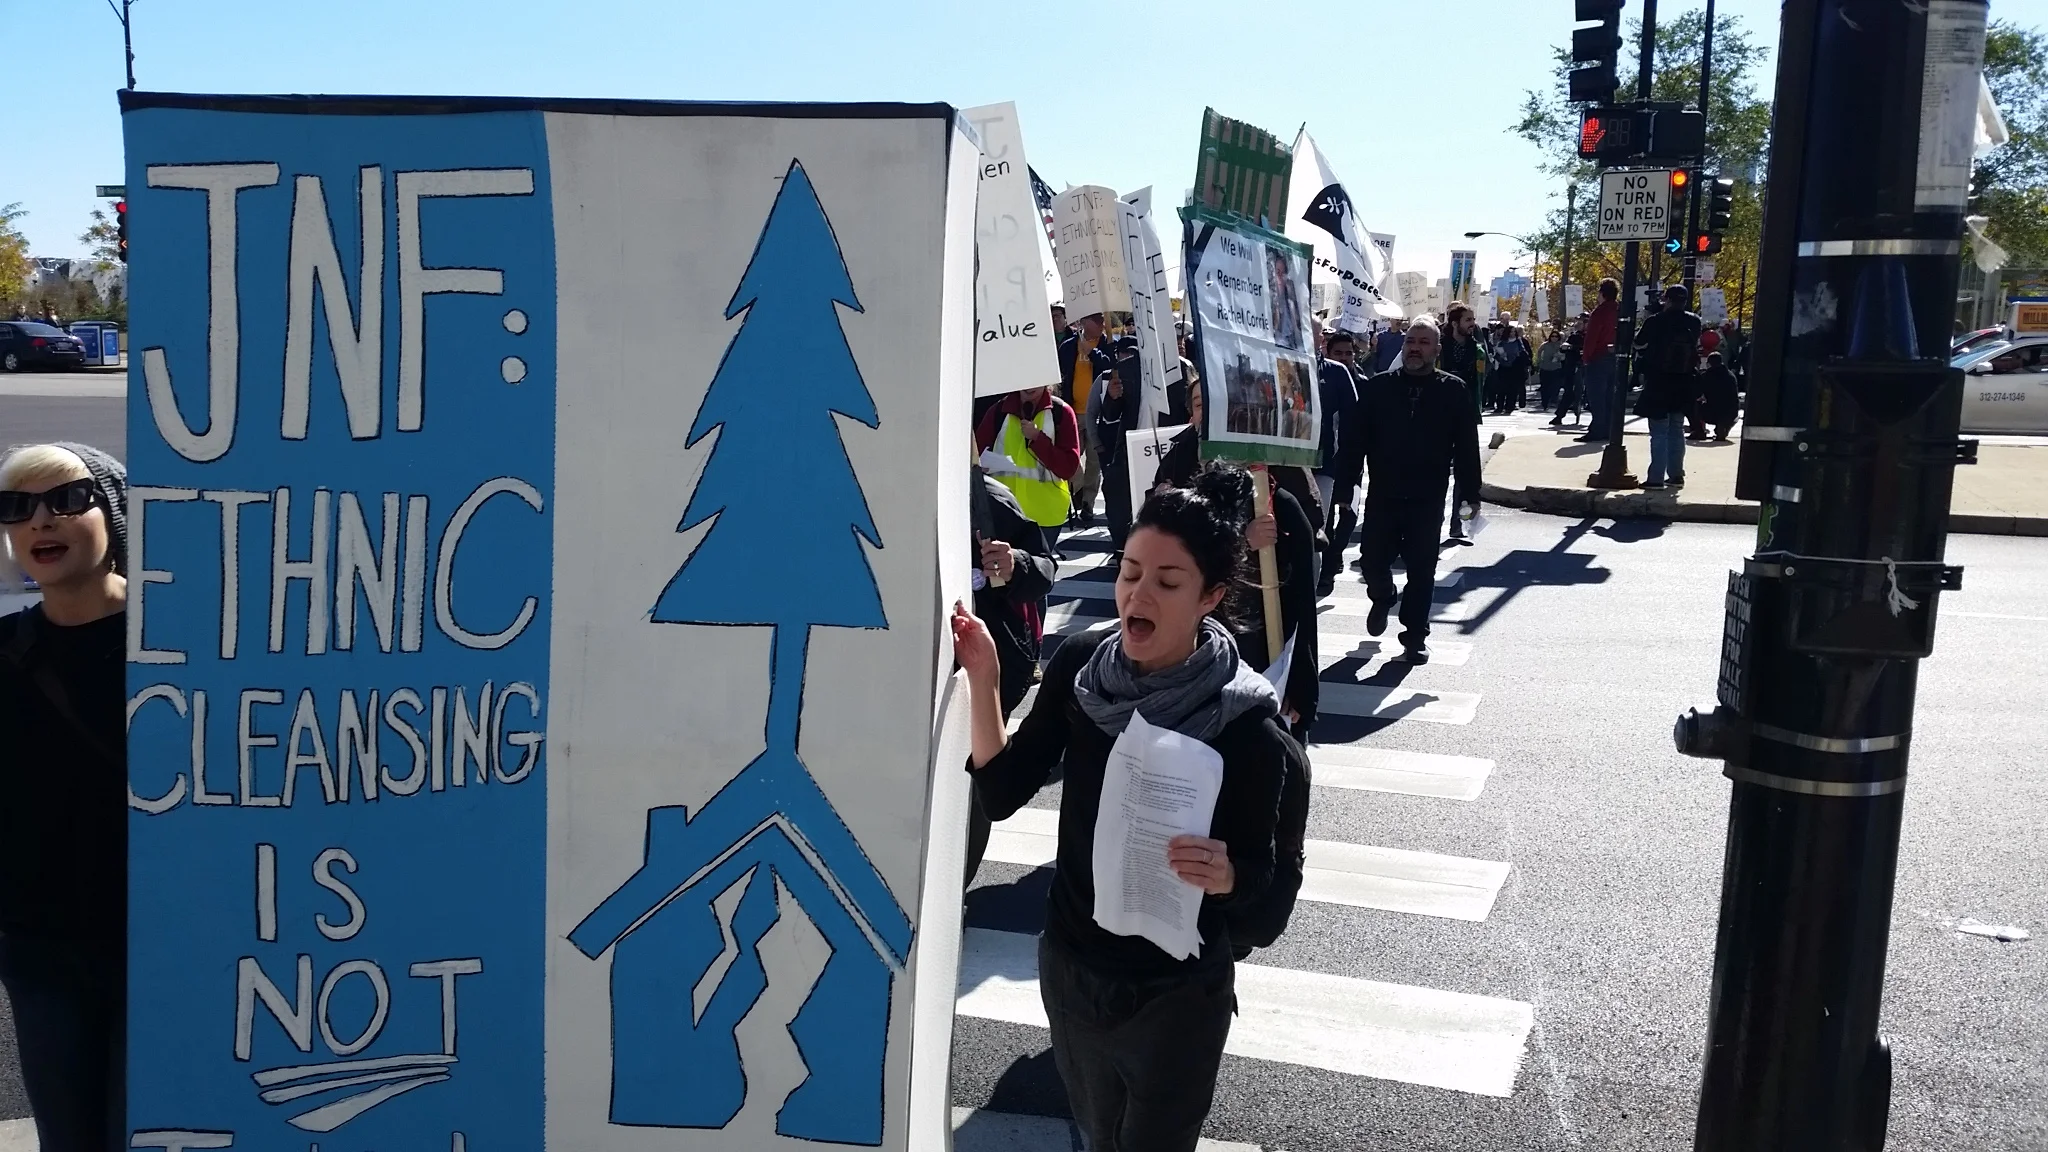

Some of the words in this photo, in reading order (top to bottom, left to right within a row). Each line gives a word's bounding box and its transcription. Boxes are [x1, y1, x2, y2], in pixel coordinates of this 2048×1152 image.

[1624, 176, 1648, 189] NO
[1072, 191, 1103, 213] JNF:
[1616, 191, 1655, 205] TURN
[1604, 208, 1624, 221] ON
[1634, 207, 1664, 220] RED
[1062, 219, 1116, 245] ETHNICALLY
[1602, 223, 1624, 234] 7AM
[1628, 224, 1639, 232] TO
[1642, 222, 1664, 233] 7PM
[1220, 236, 1236, 256] We
[1238, 242, 1253, 261] Will
[1374, 239, 1391, 248] ORE
[1070, 279, 1097, 301] SINCE
[1217, 269, 1262, 296] Remember
[142, 161, 535, 463] JNF:
[1217, 303, 1244, 325] Rachel
[1246, 310, 1269, 330] Corrie
[1979, 392, 2026, 402] 312-274-1346
[127, 476, 544, 664] ETHNIC
[127, 680, 546, 815] CLEANSING
[255, 842, 366, 942] IS
[233, 953, 484, 1061] NOT
